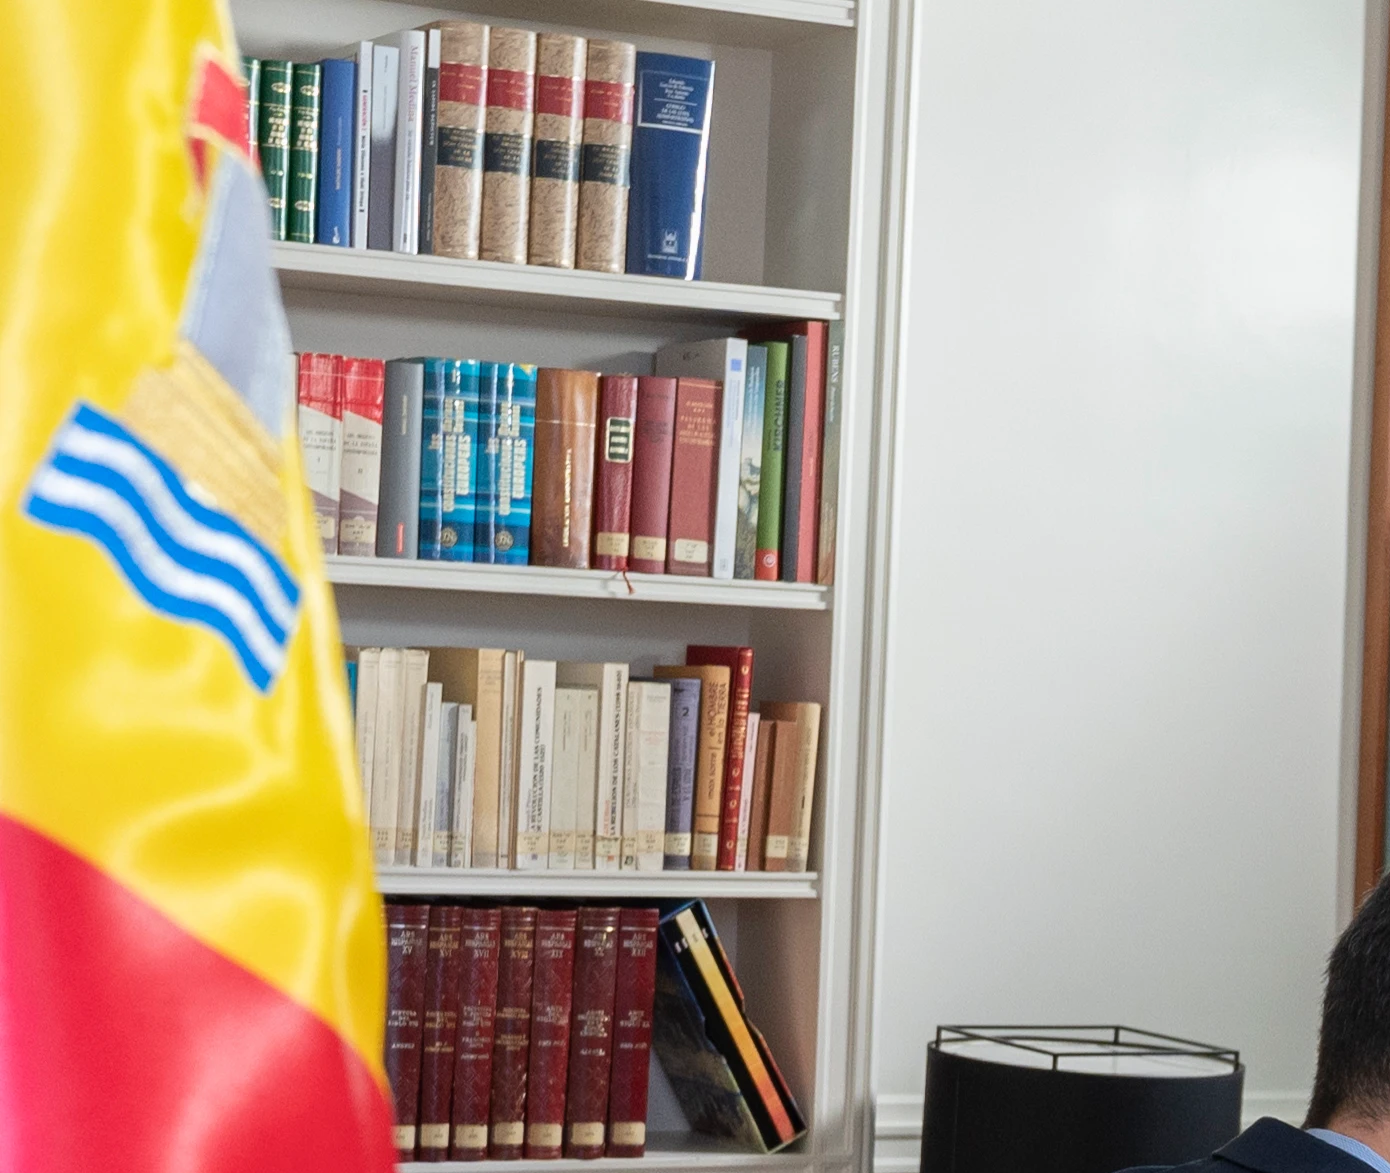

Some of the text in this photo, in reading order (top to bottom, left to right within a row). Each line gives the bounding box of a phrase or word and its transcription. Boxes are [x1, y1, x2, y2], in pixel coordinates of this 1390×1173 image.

[831, 345, 840, 383] RUBENS
[773, 380, 785, 452] KIRCHNER
[682, 708, 689, 717] 2
[709, 683, 719, 725] HOMBRE
[718, 683, 727, 715] TIERRA
